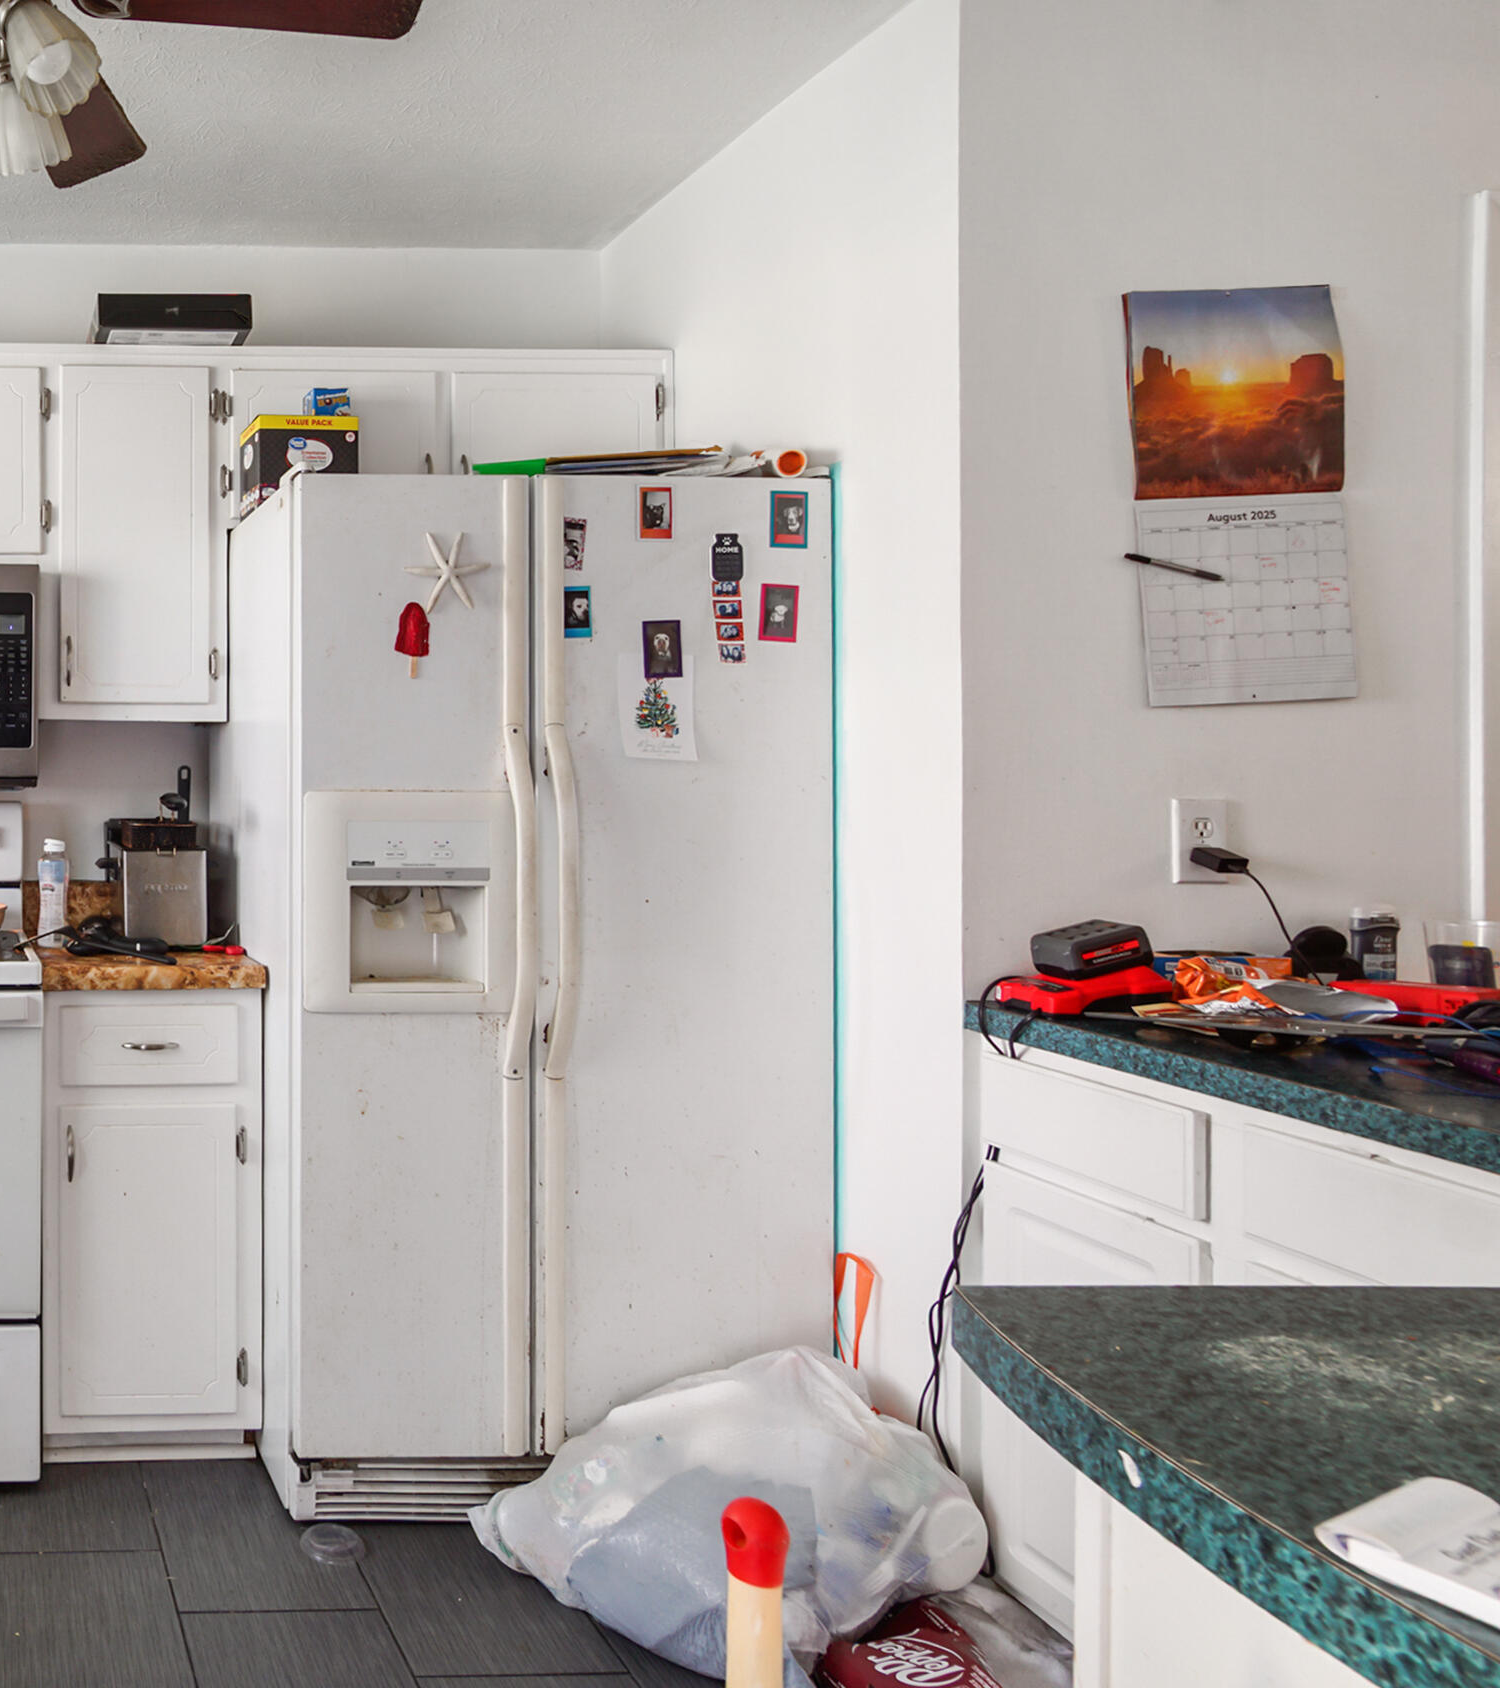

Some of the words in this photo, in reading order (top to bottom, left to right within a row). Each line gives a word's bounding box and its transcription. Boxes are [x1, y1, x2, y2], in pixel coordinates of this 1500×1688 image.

[285, 418, 309, 426] VALUE
[311, 418, 333, 426] PACK
[1207, 512, 1248, 524] August
[1250, 510, 1277, 520] 2025
[715, 546, 740, 554] HOME
[867, 1640, 966, 1688] Pepper
[867, 1655, 916, 1676] Dr
